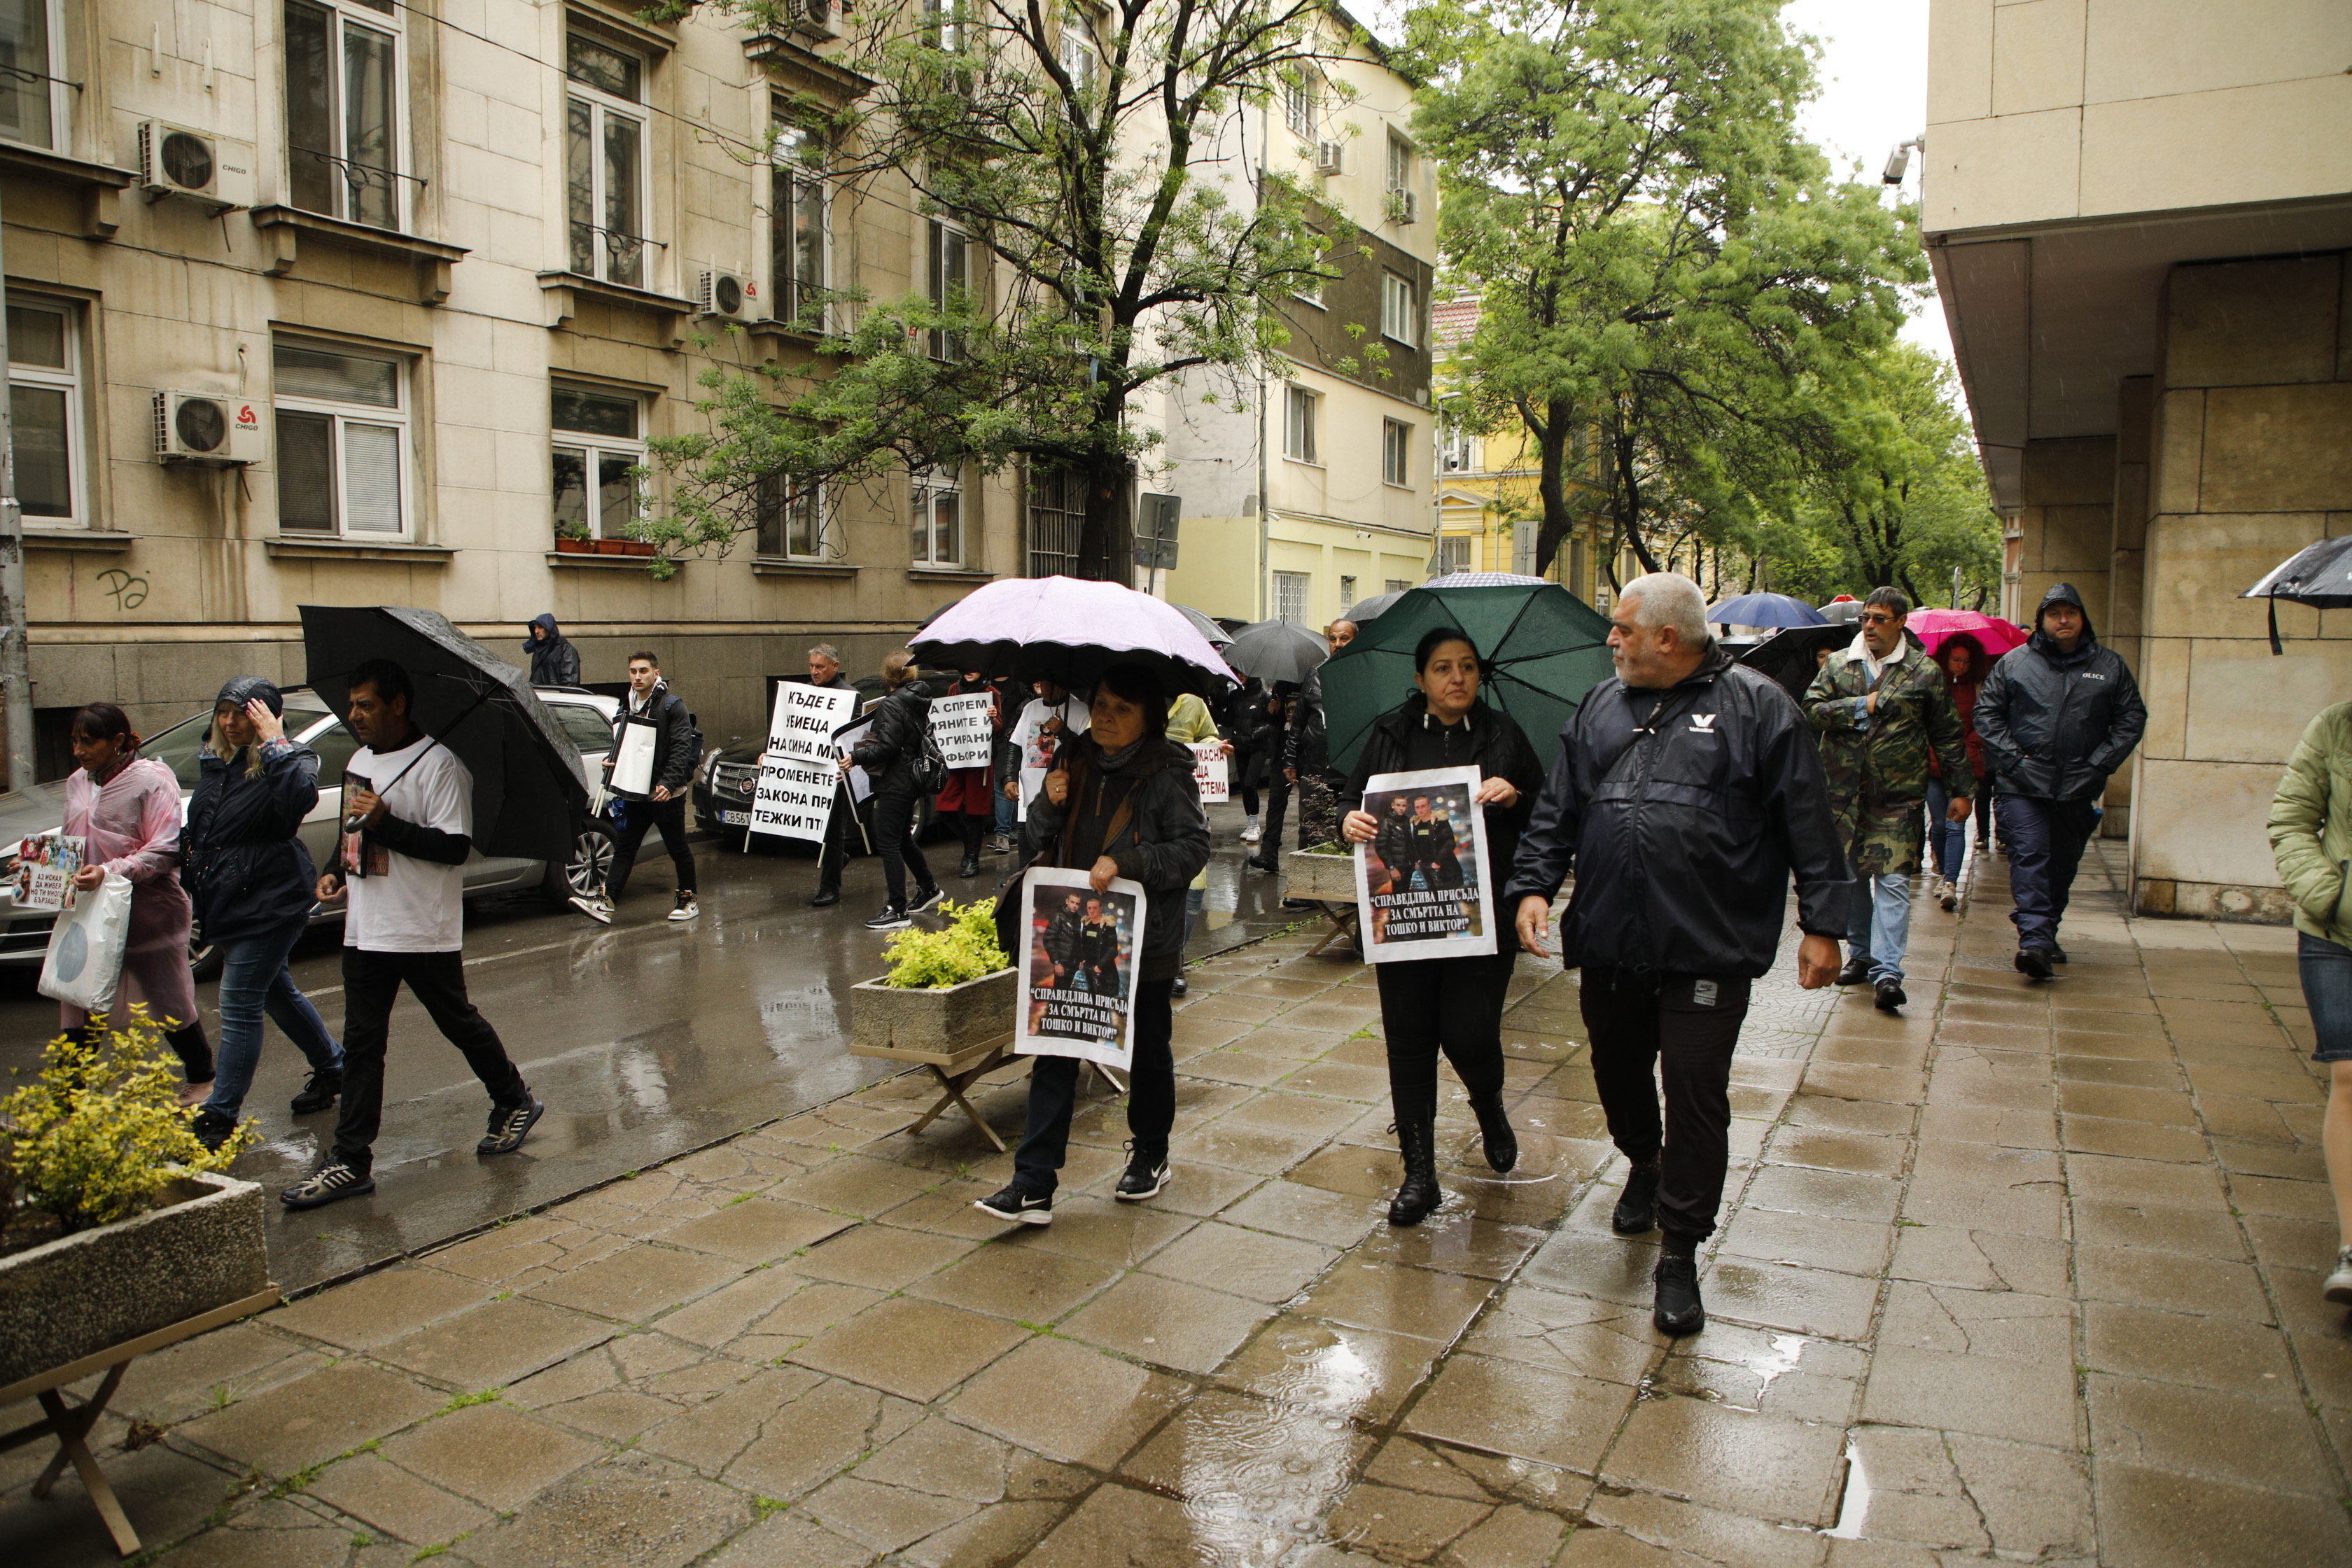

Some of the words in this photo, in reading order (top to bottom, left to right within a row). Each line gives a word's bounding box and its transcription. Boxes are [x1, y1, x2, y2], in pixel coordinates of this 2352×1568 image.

[223, 164, 246, 174] CHIGO
[788, 690, 825, 709] КЪДЕ
[827, 697, 836, 710] Е
[943, 699, 988, 713] СПРЕМ
[786, 714, 830, 734] УБИЕЦА
[760, 765, 834, 787] ПРОМЕНЕТЕ
[757, 788, 808, 806] ЗАКОНА
[755, 809, 802, 827] ТЕЖКИ
[1437, 888, 1479, 902] ПРИСЪДА
[1390, 909, 1401, 921] ЗА
[1403, 905, 1444, 920] СМЪРТТА
[1446, 904, 1459, 916] НА
[1385, 921, 1418, 936] ТОШКО
[1419, 920, 1427, 933] И
[1095, 994, 1128, 1014] ПРИСЪДА
[1048, 1003, 1059, 1016] ЗА
[1060, 1005, 1098, 1021] СМЪРТТА
[1100, 1011, 1111, 1024] НА
[1041, 1018, 1072, 1032] ТОШКО
[1074, 1021, 1081, 1033] И
